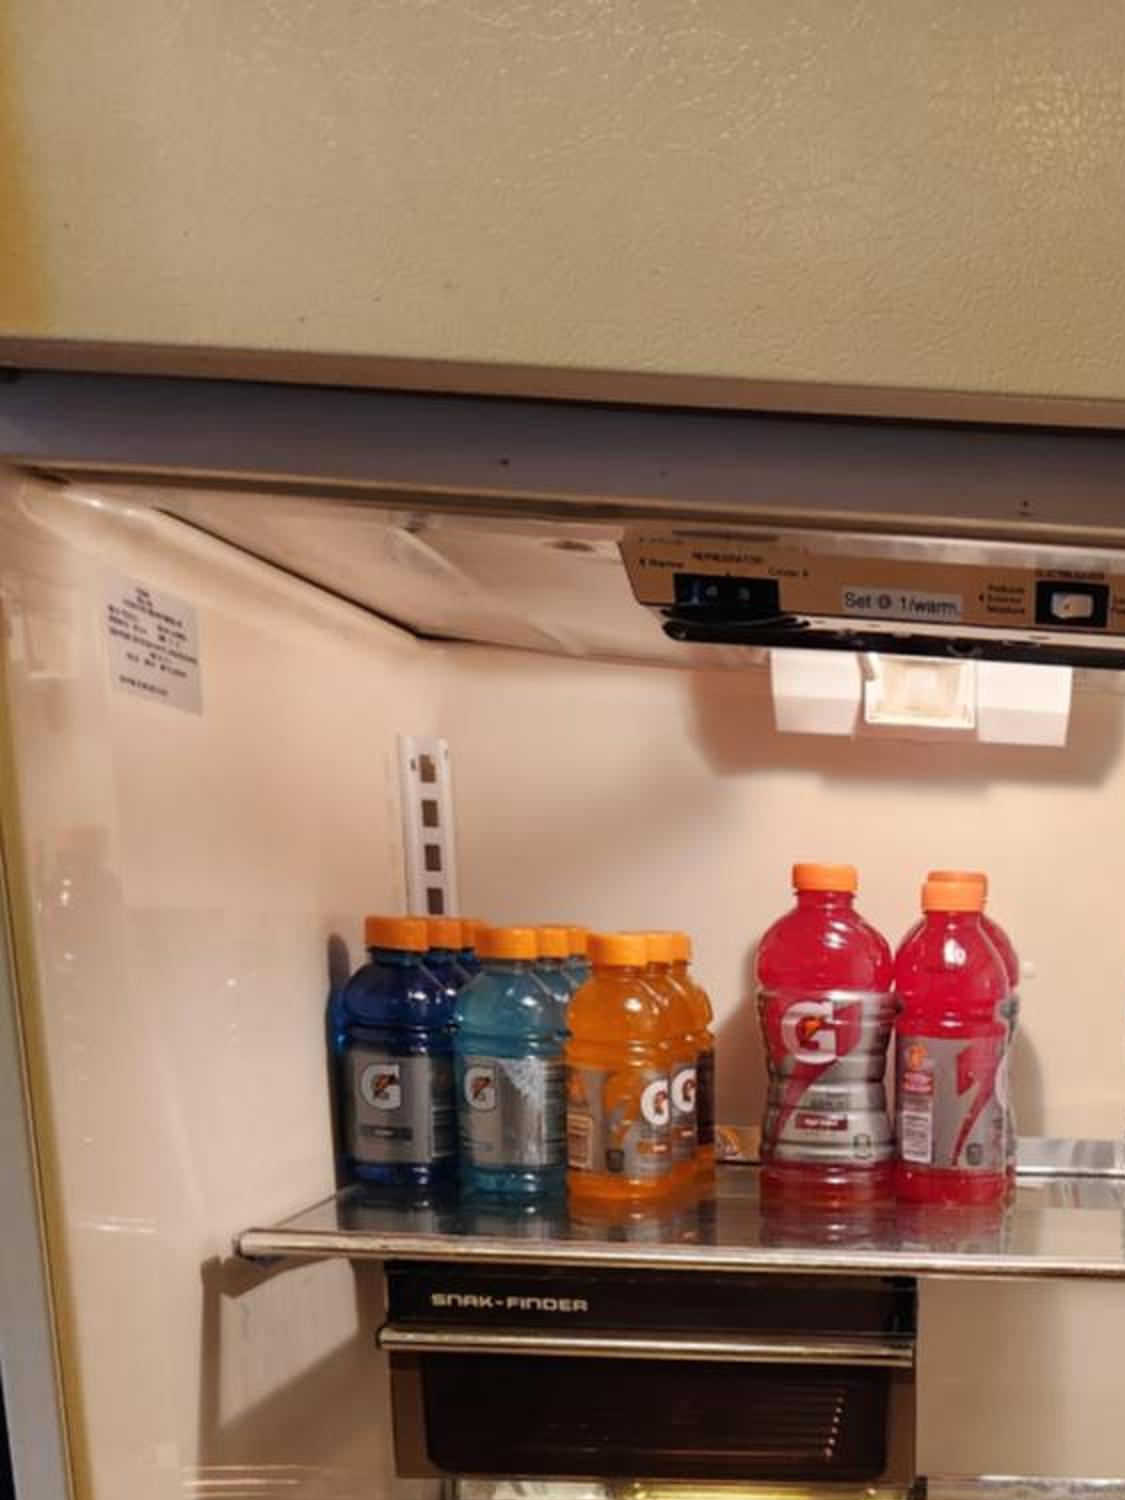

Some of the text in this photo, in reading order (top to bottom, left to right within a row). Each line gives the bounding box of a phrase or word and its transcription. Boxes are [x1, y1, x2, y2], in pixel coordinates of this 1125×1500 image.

[844, 591, 872, 608] Set
[780, 1001, 838, 1064] G
[361, 1063, 401, 1110] G
[431, 1293, 588, 1312] SNAK-FINDER
